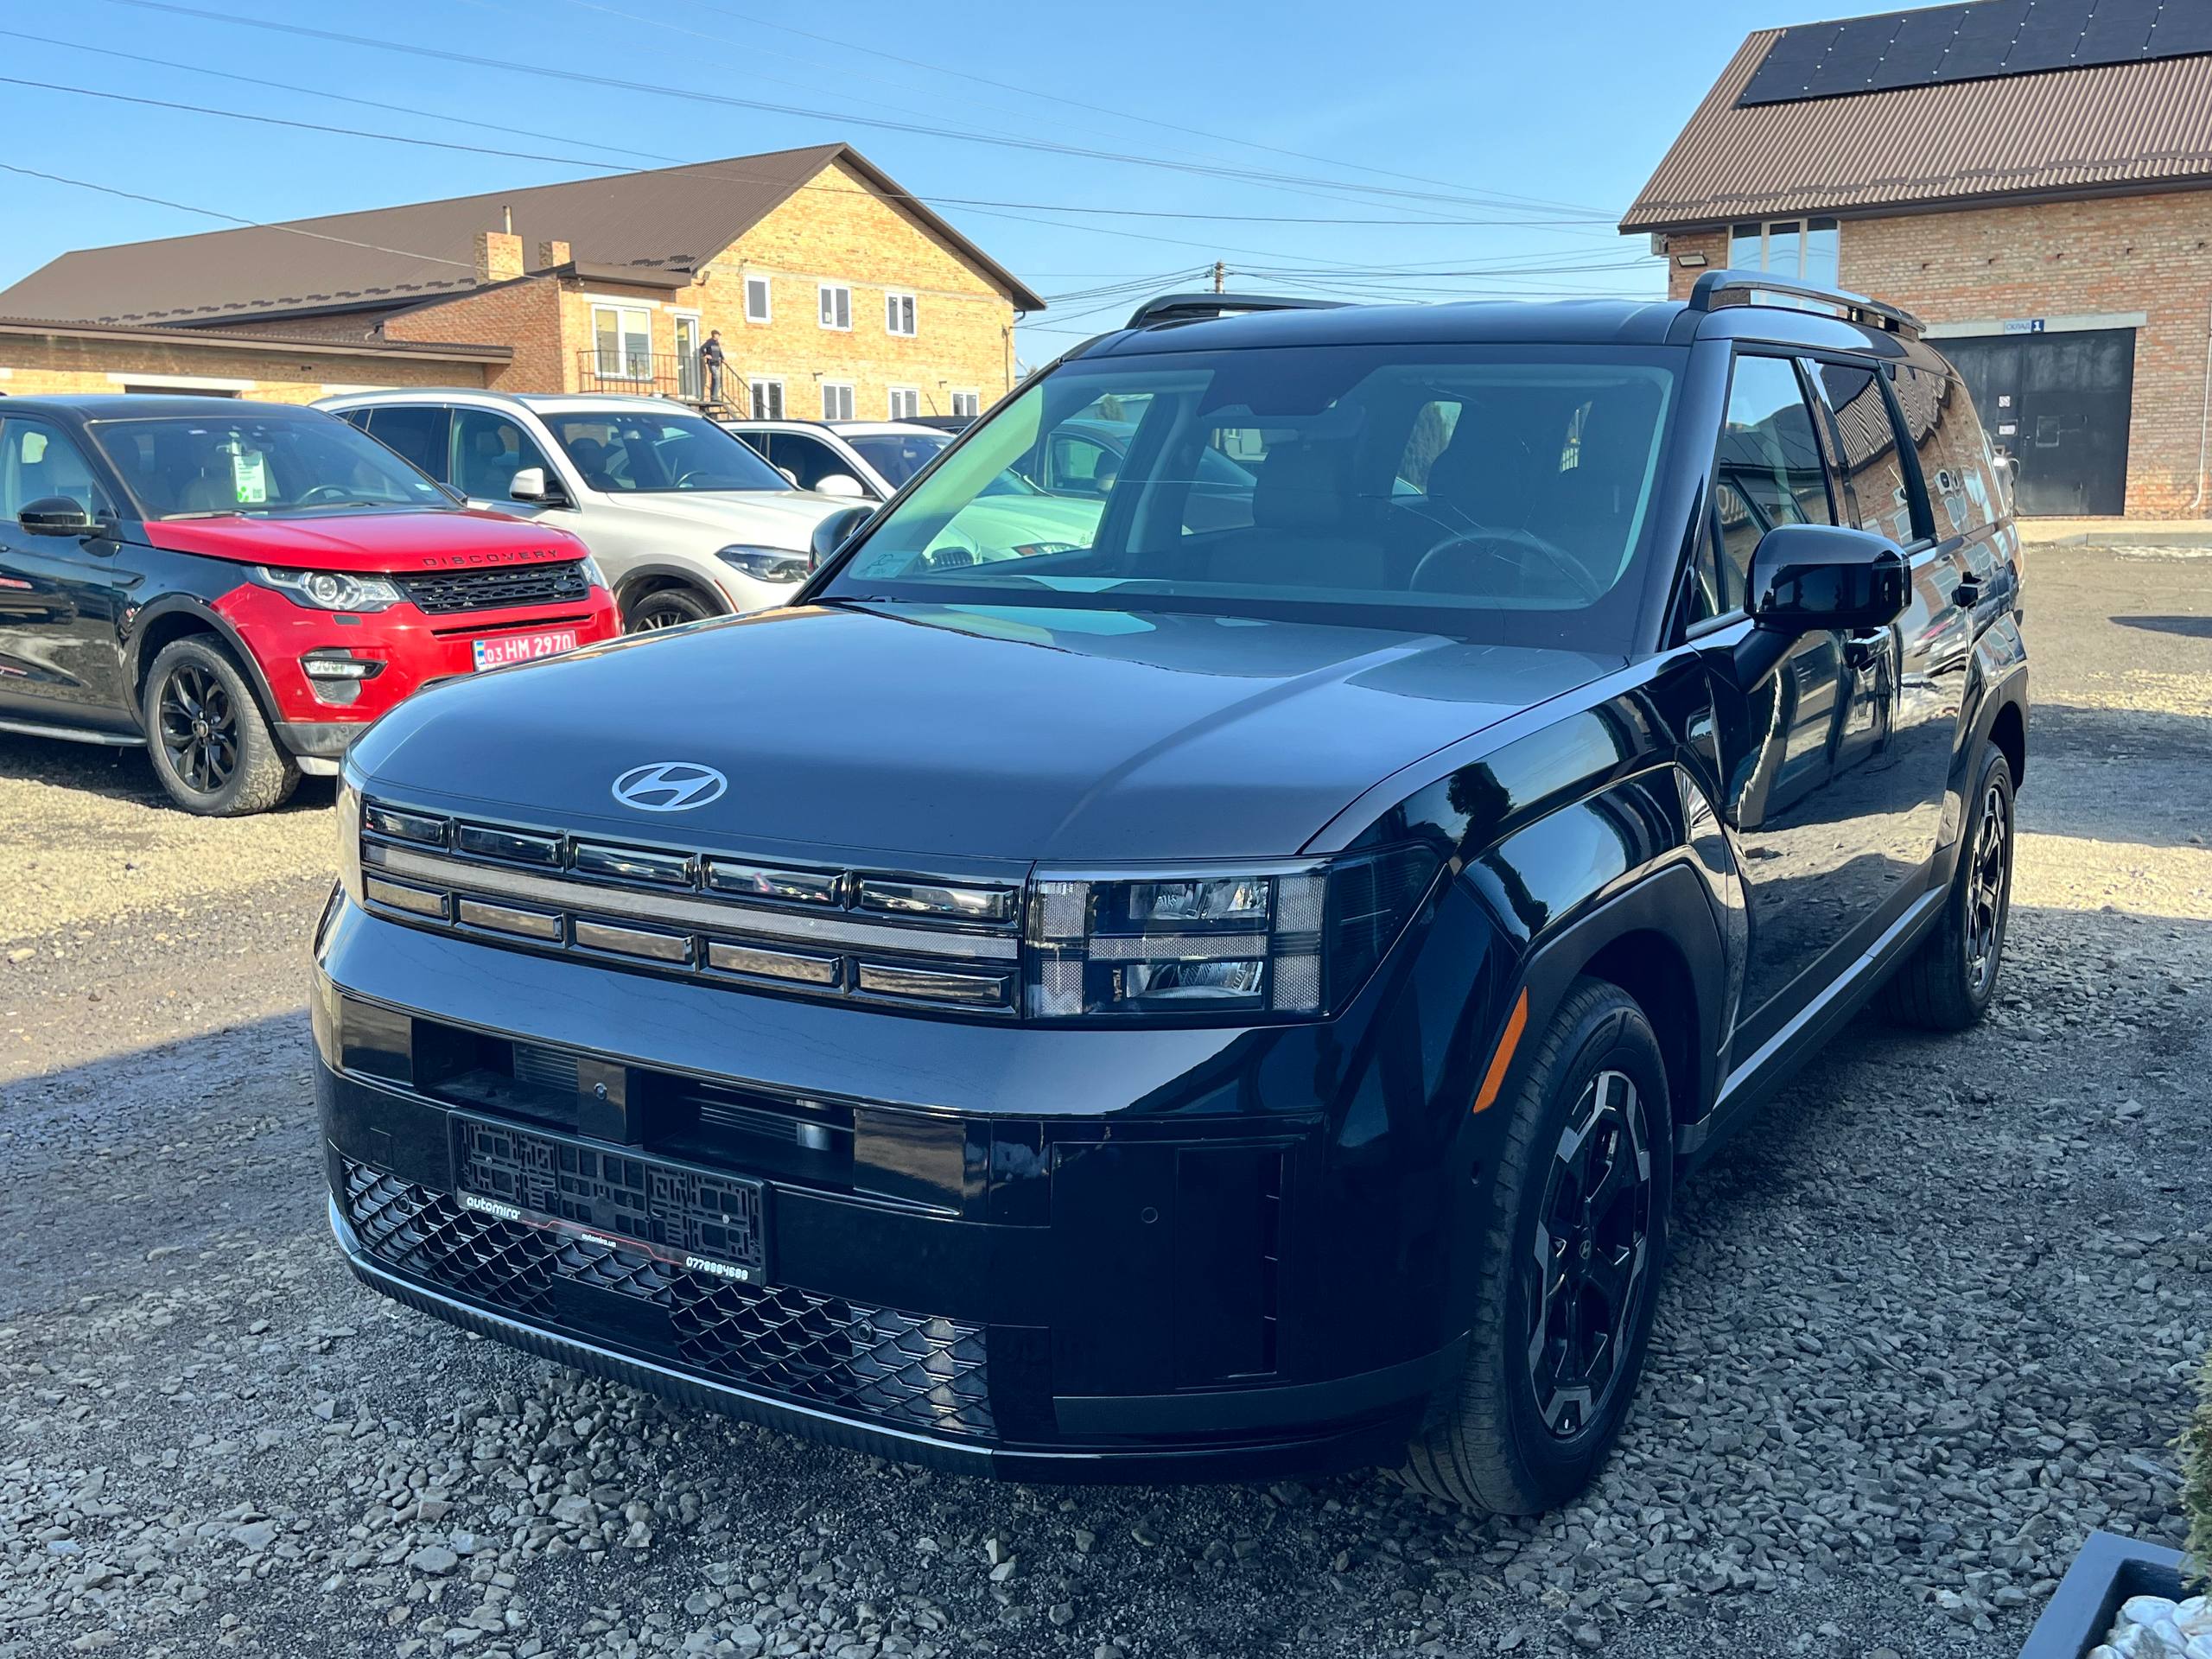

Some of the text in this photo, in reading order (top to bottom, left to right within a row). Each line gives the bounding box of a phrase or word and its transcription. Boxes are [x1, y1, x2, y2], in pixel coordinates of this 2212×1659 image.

[2033, 321, 2041, 332] 1
[423, 550, 557, 566] DISCOVERY
[486, 647, 503, 663] 03
[534, 634, 571, 657] 2970
[467, 1197, 518, 1220] automira
